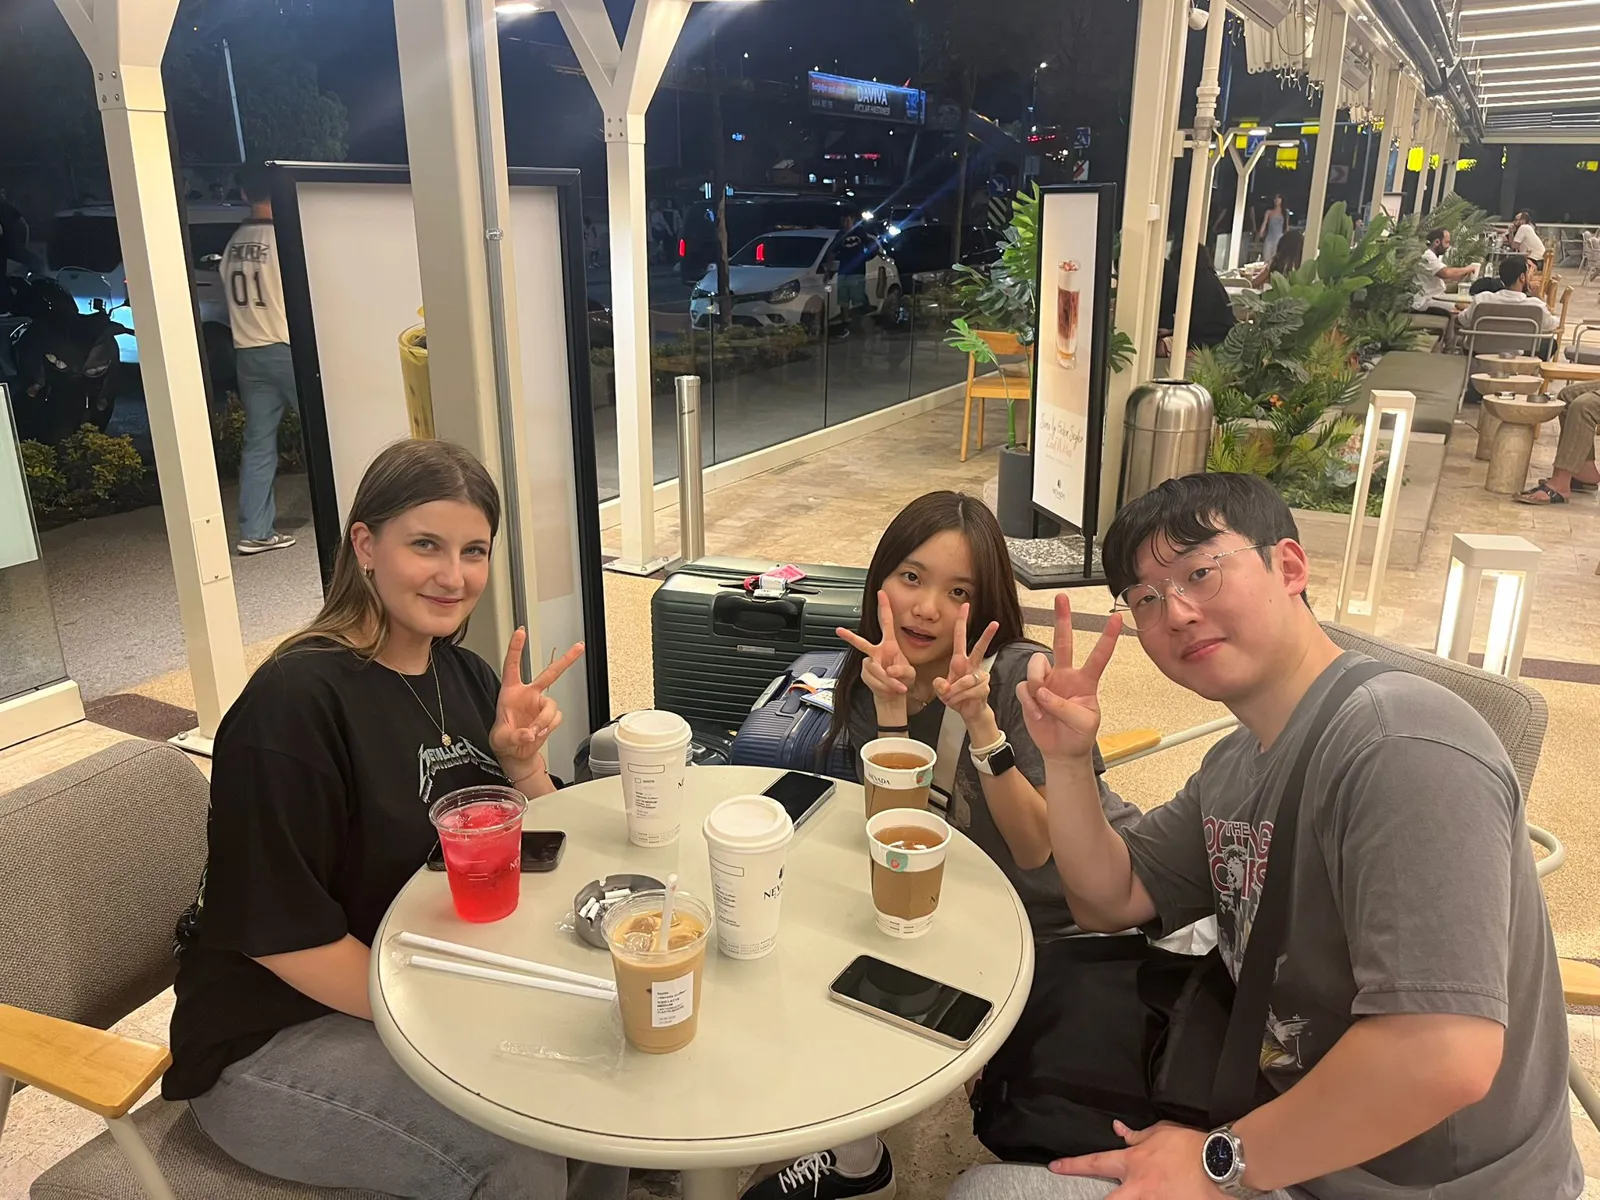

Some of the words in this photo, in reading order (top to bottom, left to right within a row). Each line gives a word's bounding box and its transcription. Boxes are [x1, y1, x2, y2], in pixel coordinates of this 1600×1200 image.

[856, 85, 889, 105] DAVIVA
[231, 270, 267, 307] 01
[418, 735, 501, 798] METALLICA
[868, 772, 891, 786] NEVADA
[1225, 821, 1251, 837] THE
